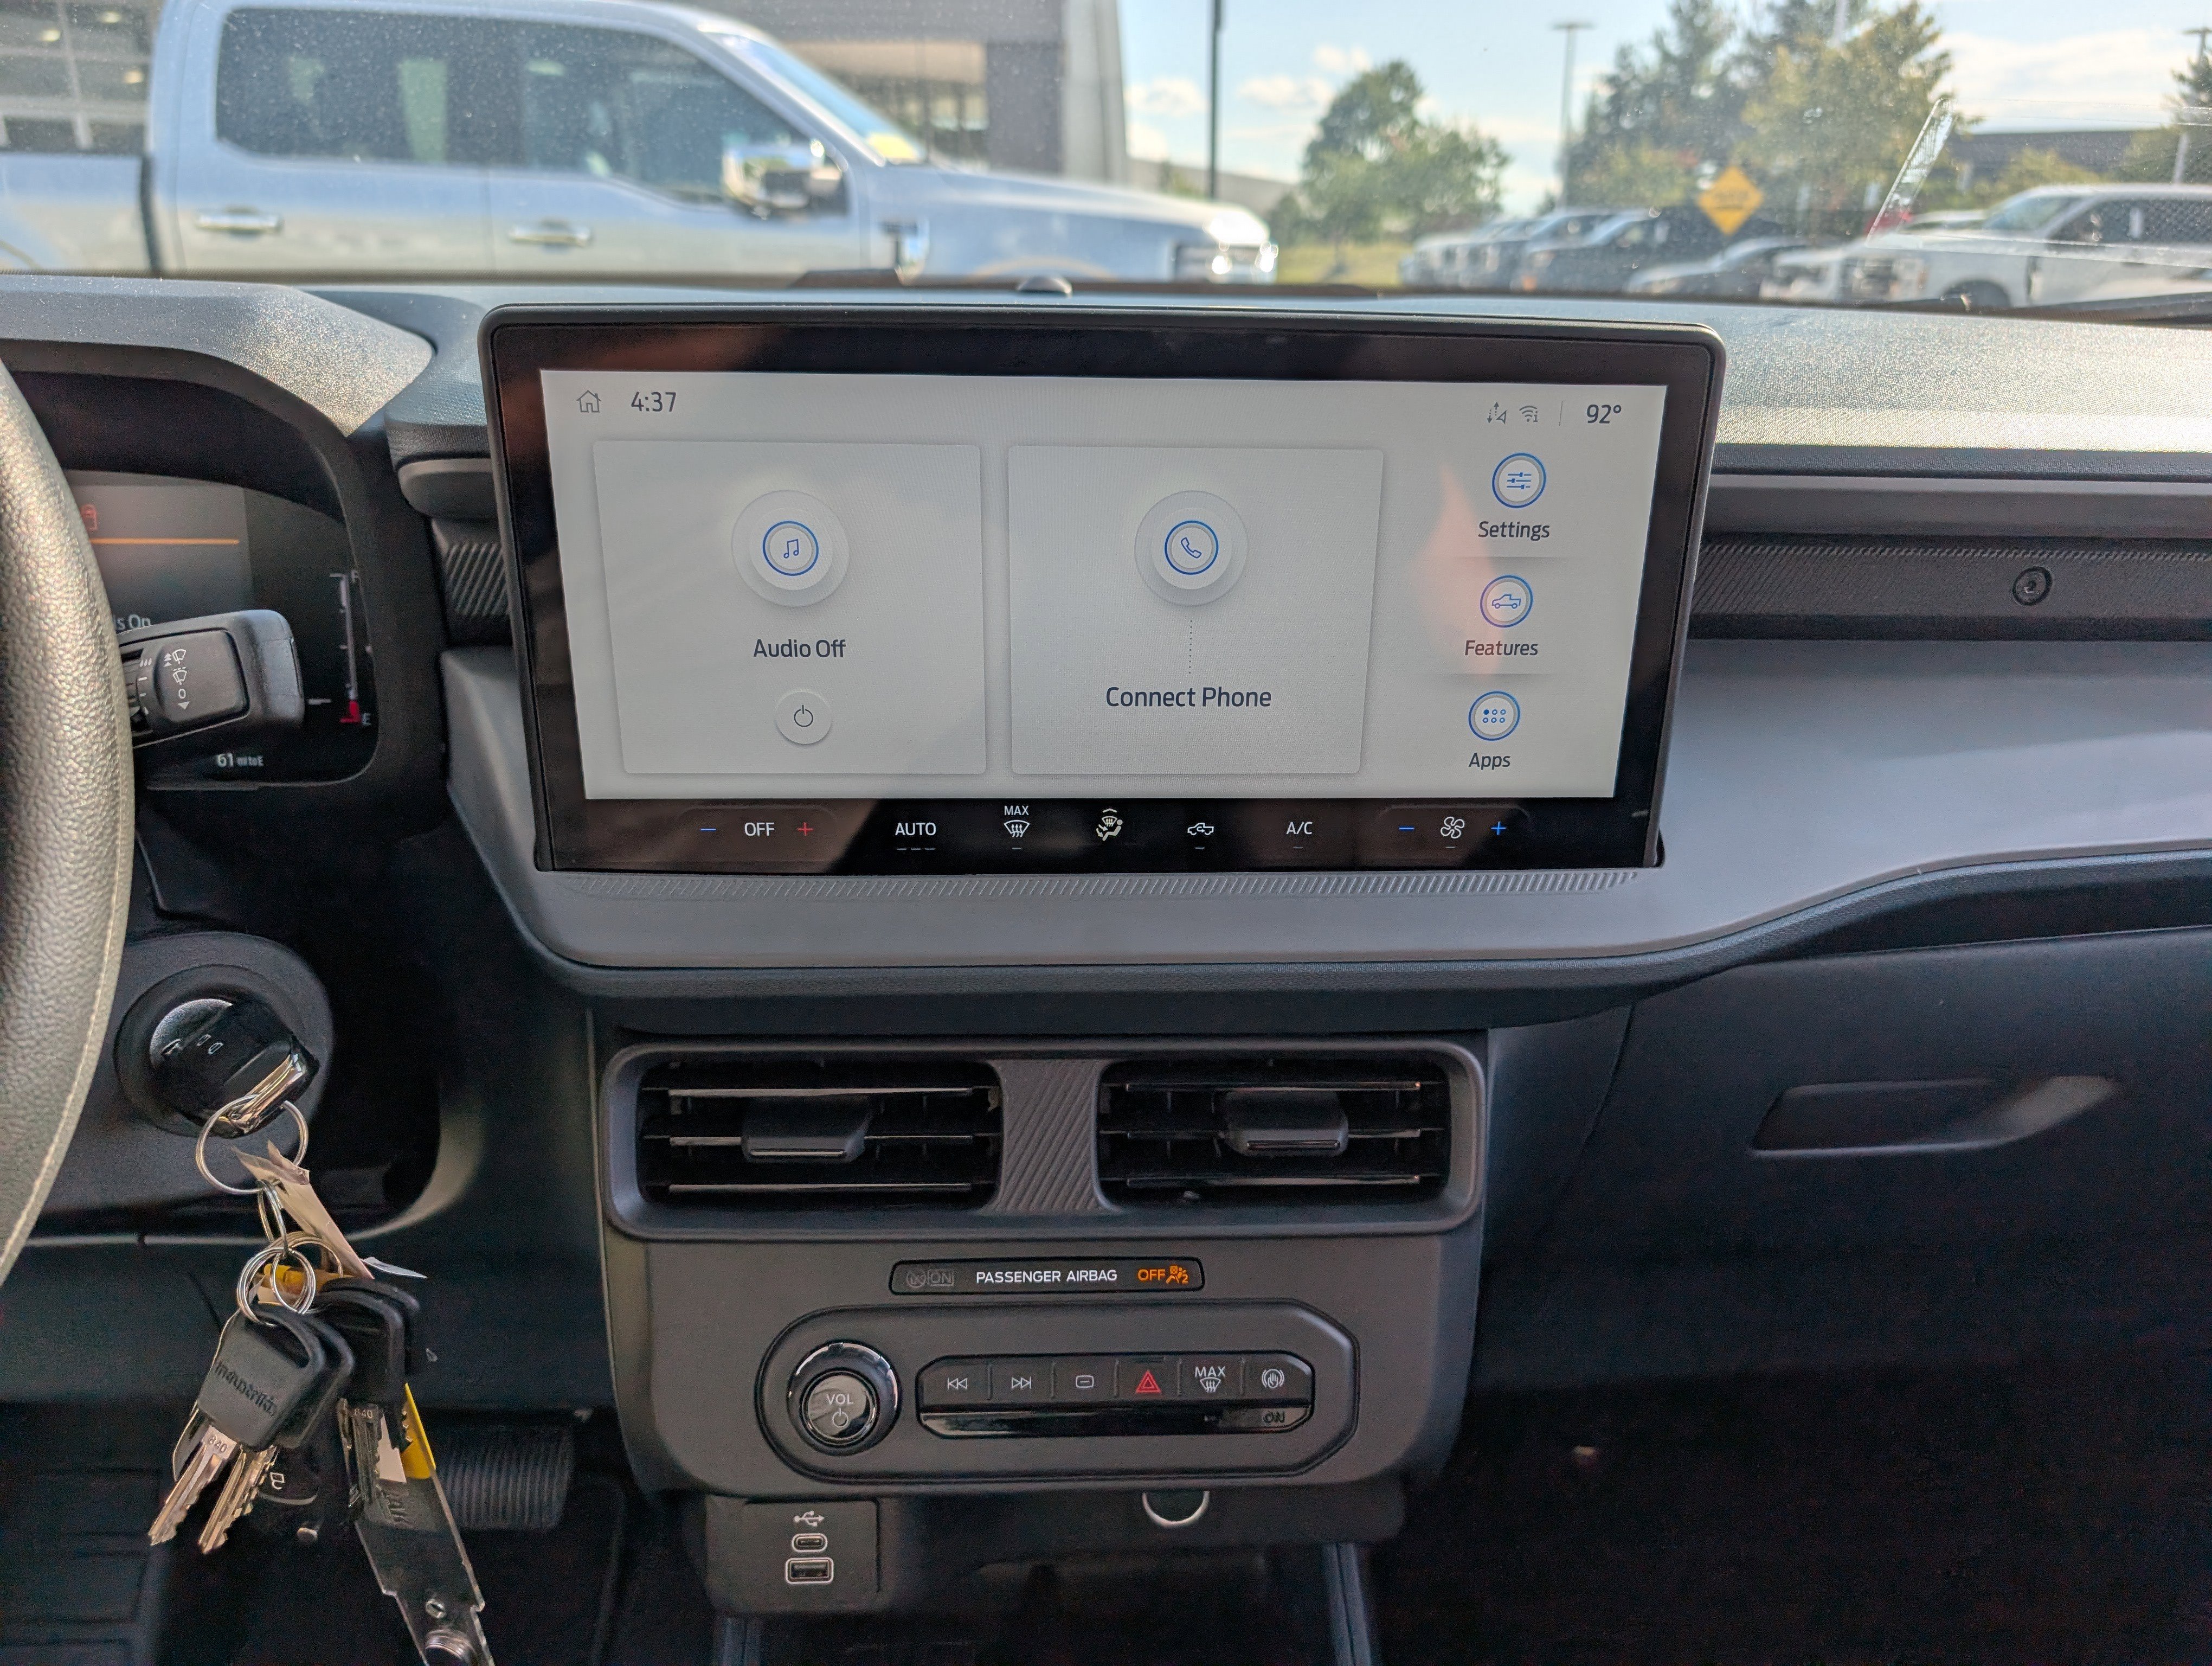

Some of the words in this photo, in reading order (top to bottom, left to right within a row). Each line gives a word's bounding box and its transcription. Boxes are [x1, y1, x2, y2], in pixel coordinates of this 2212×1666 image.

[631, 392, 677, 412] 4:37
[1586, 404, 1622, 424] 92°
[1478, 521, 1550, 541] Settings
[753, 638, 811, 657] Audio
[815, 639, 846, 658] Off
[1465, 640, 1538, 656] Features
[1106, 687, 1196, 707] Connect
[1202, 686, 1271, 707] Phone
[217, 753, 234, 767] 61
[1468, 752, 1510, 770] Apps
[1004, 805, 1029, 816] MAX
[744, 822, 775, 836] OFF
[895, 822, 936, 836] AUTO
[1286, 821, 1313, 835] A/C
[976, 1271, 1061, 1284] PASSENGER
[1066, 1269, 1117, 1281] AIRBAG
[1137, 1268, 1166, 1281] OFF
[1194, 1366, 1226, 1378] MAX
[826, 1393, 854, 1405] VOL
[208, 1434, 228, 1453] 840
